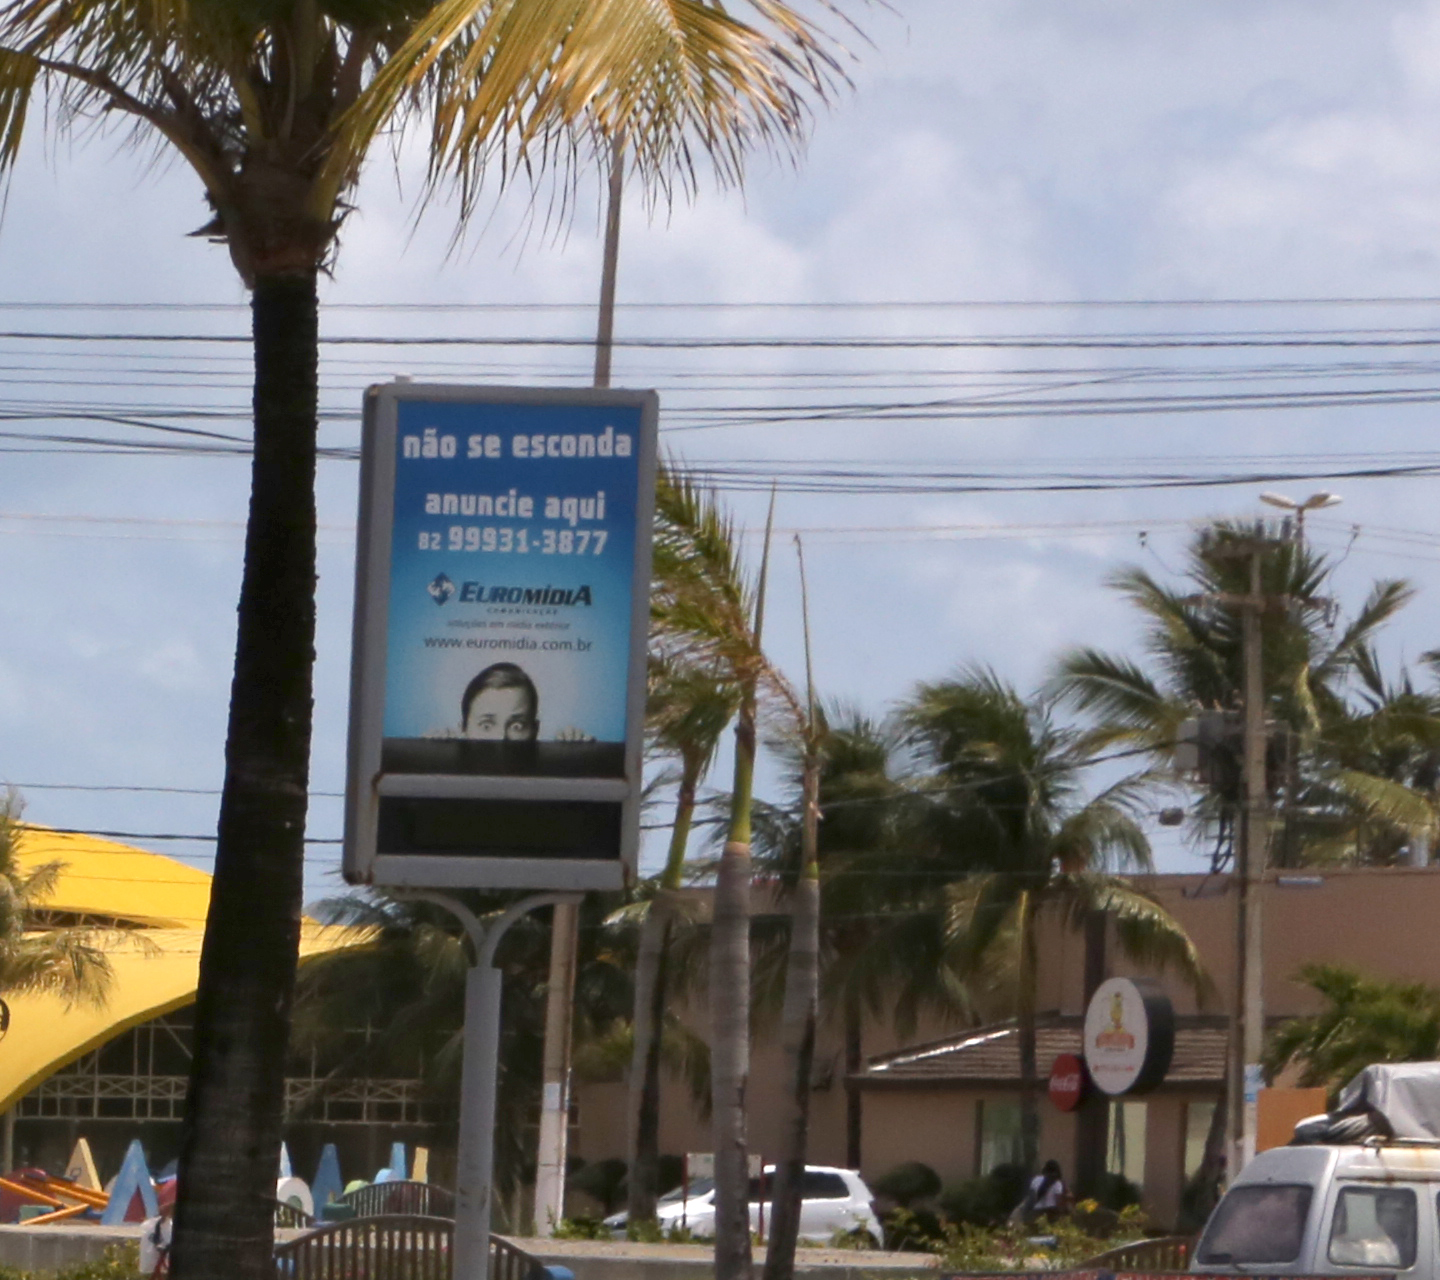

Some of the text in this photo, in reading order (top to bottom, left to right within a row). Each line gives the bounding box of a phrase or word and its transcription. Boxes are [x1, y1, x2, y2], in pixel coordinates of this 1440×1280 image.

[403, 426, 632, 459] não se esconda
[425, 488, 606, 527] anuncie aqui
[448, 525, 609, 556] 99931-3877
